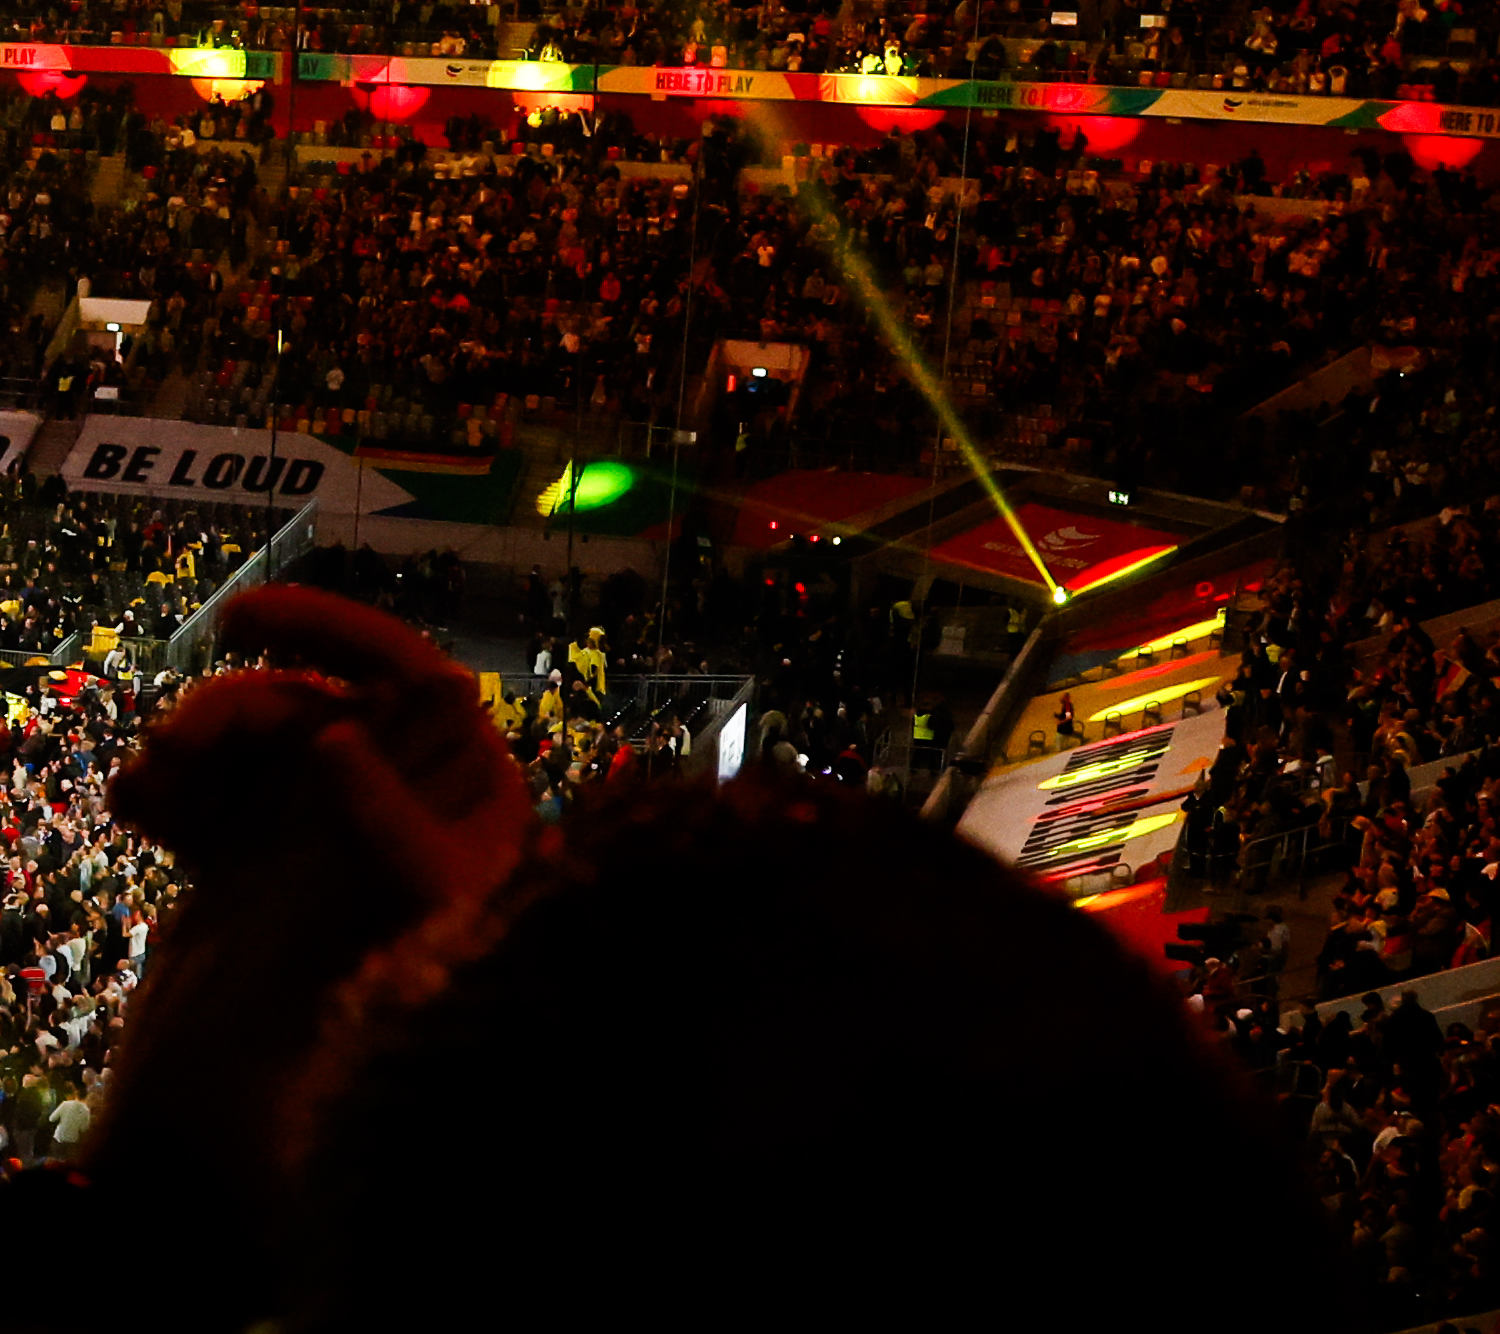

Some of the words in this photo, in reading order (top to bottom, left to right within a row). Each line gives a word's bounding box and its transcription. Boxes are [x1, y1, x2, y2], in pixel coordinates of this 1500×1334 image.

[3, 48, 37, 65] PLAY
[656, 69, 691, 91] HERE
[696, 72, 714, 93] TO
[717, 72, 754, 94] PLAY
[976, 85, 1013, 104] HERE
[1019, 87, 1038, 105] TO
[1440, 110, 1474, 132] HERE
[1477, 112, 1495, 133] TO
[84, 442, 163, 480] BE
[170, 450, 326, 497] LOUD
